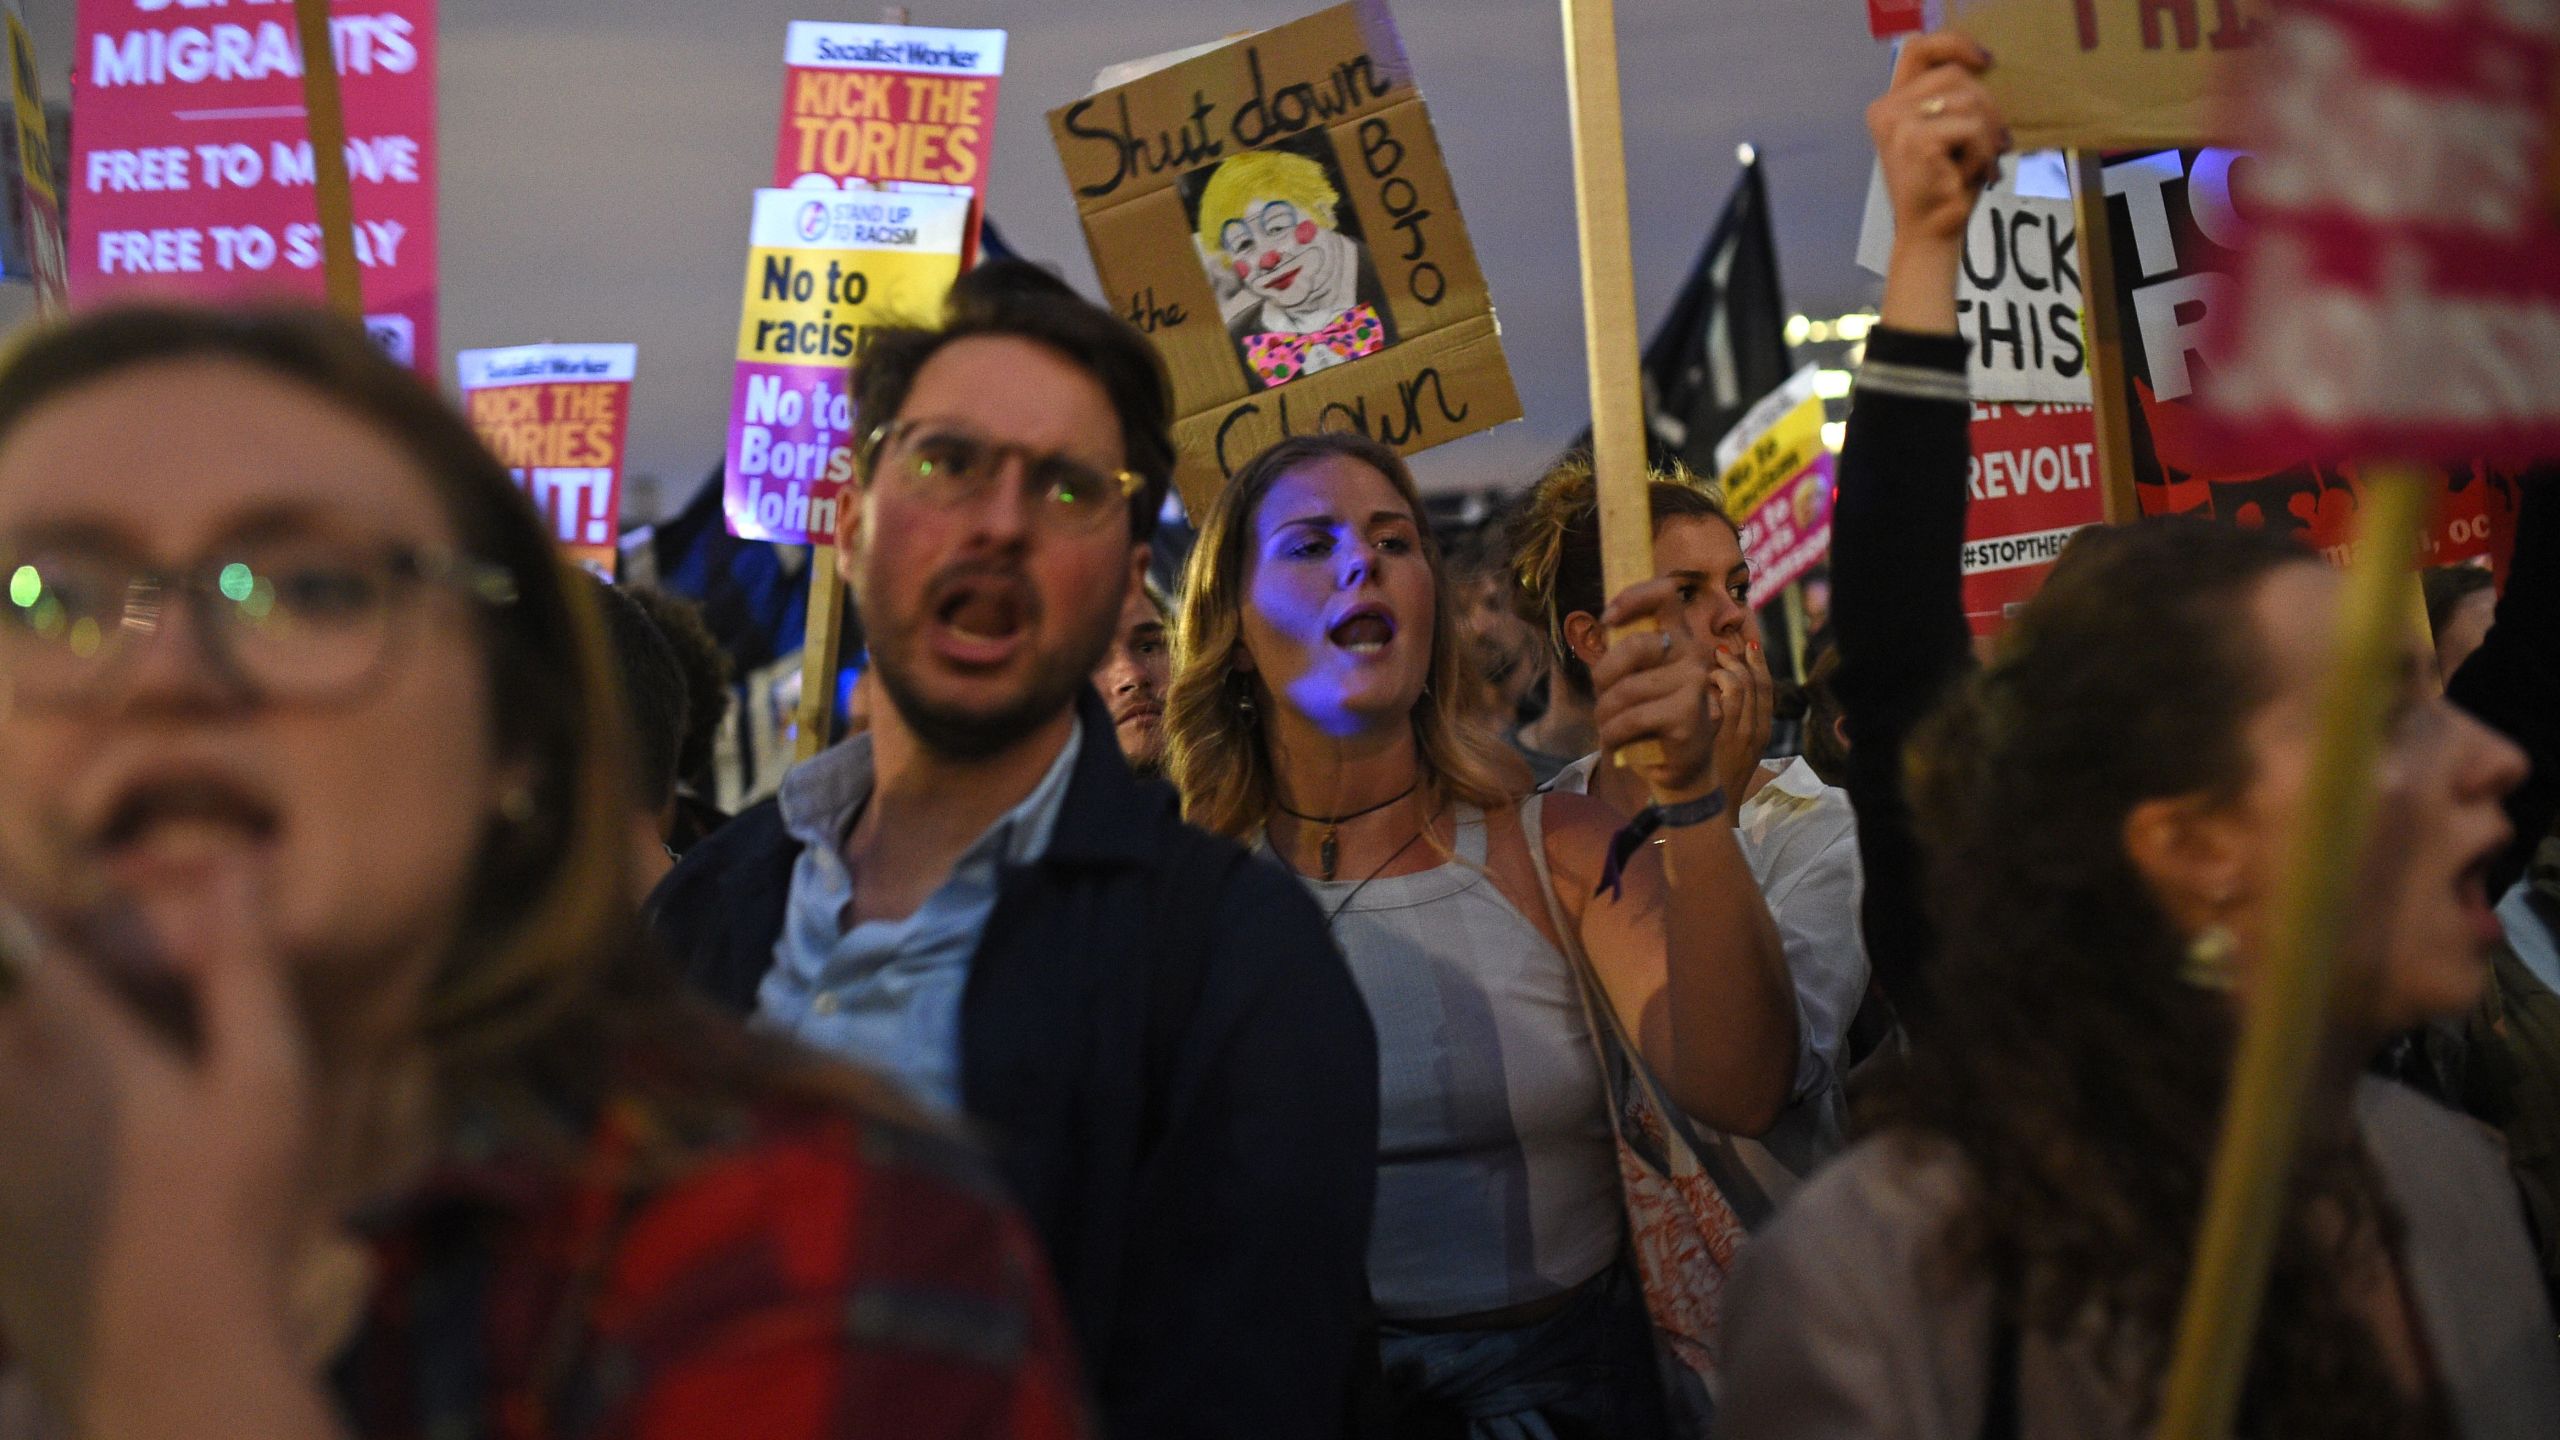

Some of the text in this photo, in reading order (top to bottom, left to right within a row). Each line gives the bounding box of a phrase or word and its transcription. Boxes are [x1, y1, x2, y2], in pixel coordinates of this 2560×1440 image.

[91, 12, 418, 88] MIGRATS
[816, 37, 981, 69] Socialist Worker
[797, 70, 986, 126] KICK THE
[1065, 46, 1393, 198] Shut down
[86, 146, 191, 193] FREE
[195, 142, 264, 189] TO
[794, 116, 980, 186] TORIES
[832, 223, 918, 245] TO RACISM
[833, 203, 911, 224] STAND UP
[97, 218, 407, 275] FREE TO SAY
[1961, 206, 2083, 294] UCK
[761, 255, 869, 305] No to
[1128, 287, 1188, 334] the
[552, 382, 618, 421] THE
[744, 373, 857, 432] No to
[738, 425, 852, 484] Boris
[1967, 442, 2093, 501] REVOLT
[738, 477, 837, 535] John
